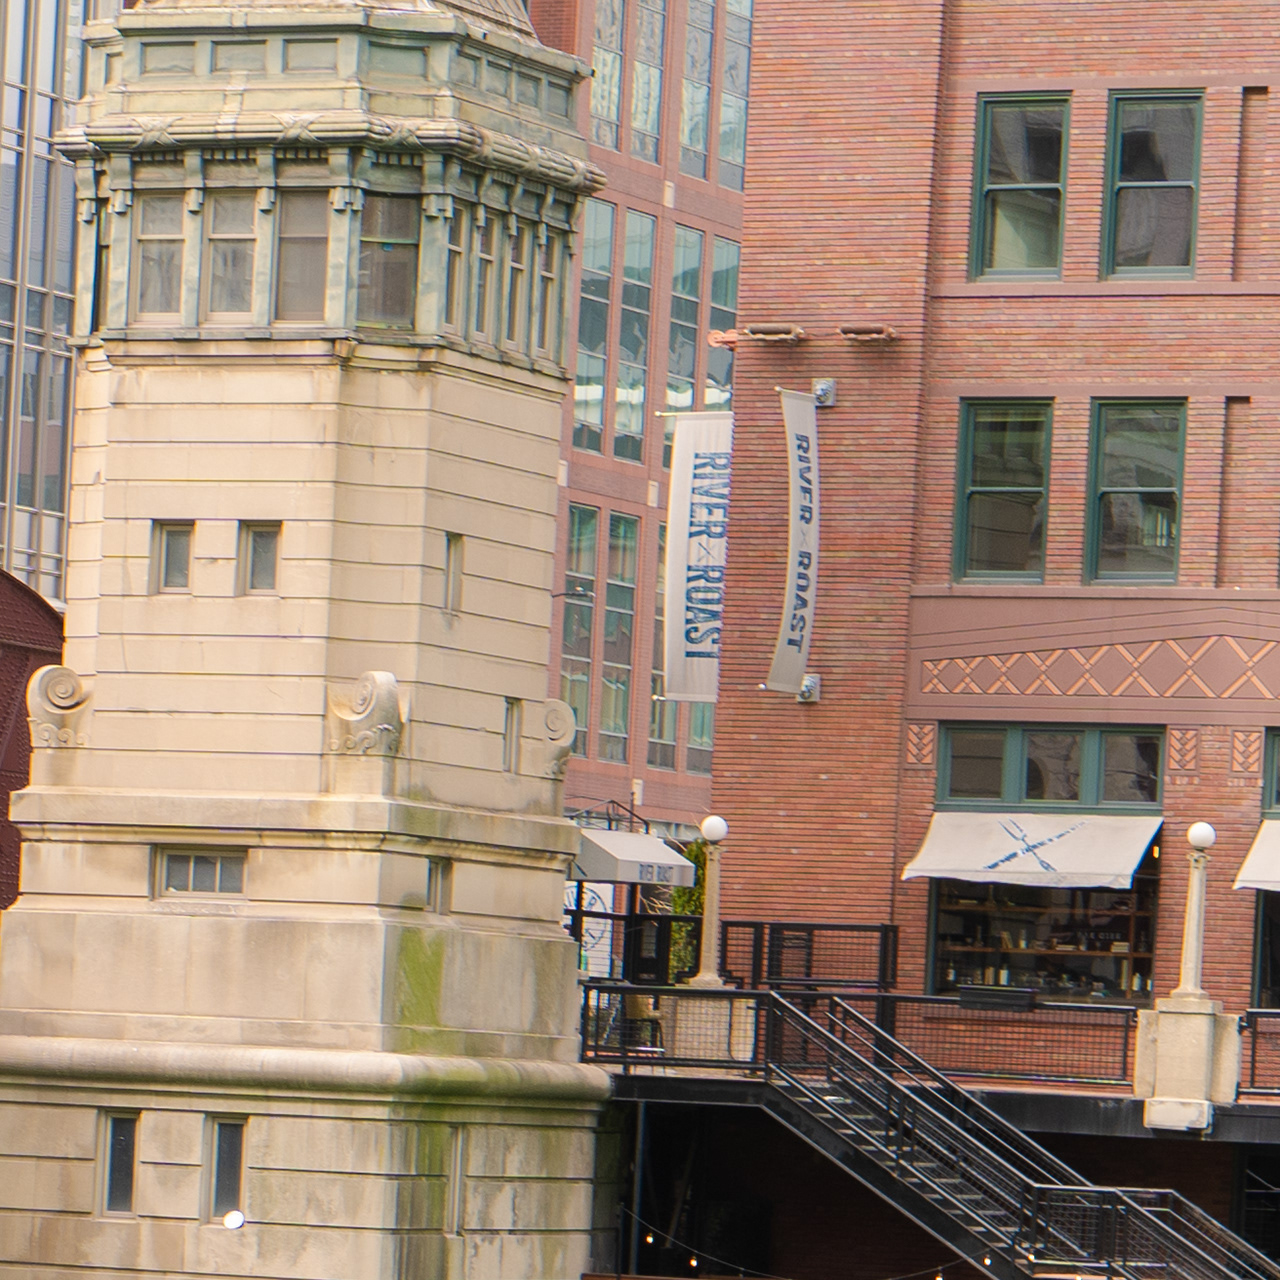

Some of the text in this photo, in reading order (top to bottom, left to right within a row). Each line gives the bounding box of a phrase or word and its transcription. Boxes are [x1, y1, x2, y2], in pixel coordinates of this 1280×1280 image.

[688, 452, 732, 539] RIVER
[786, 433, 812, 653] RIVER ROAST
